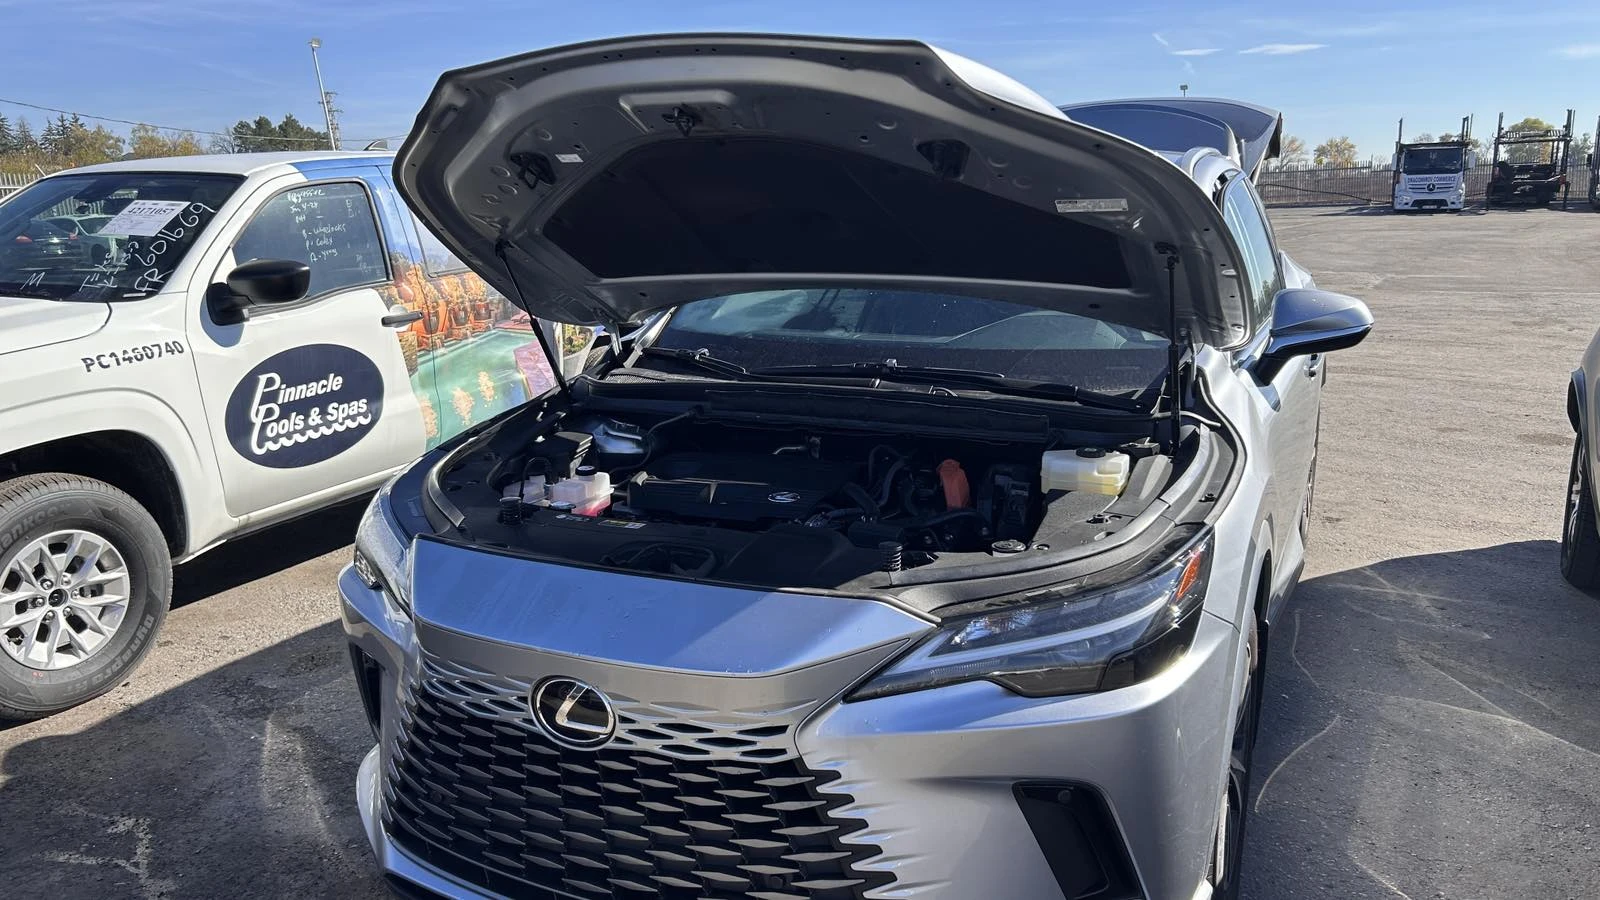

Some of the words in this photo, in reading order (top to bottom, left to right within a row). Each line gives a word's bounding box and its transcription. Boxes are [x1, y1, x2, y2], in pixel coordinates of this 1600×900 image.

[251, 372, 343, 423] Pinnacle
[251, 402, 305, 455] Pools
[308, 407, 323, 427] &
[326, 398, 368, 424] Spas
